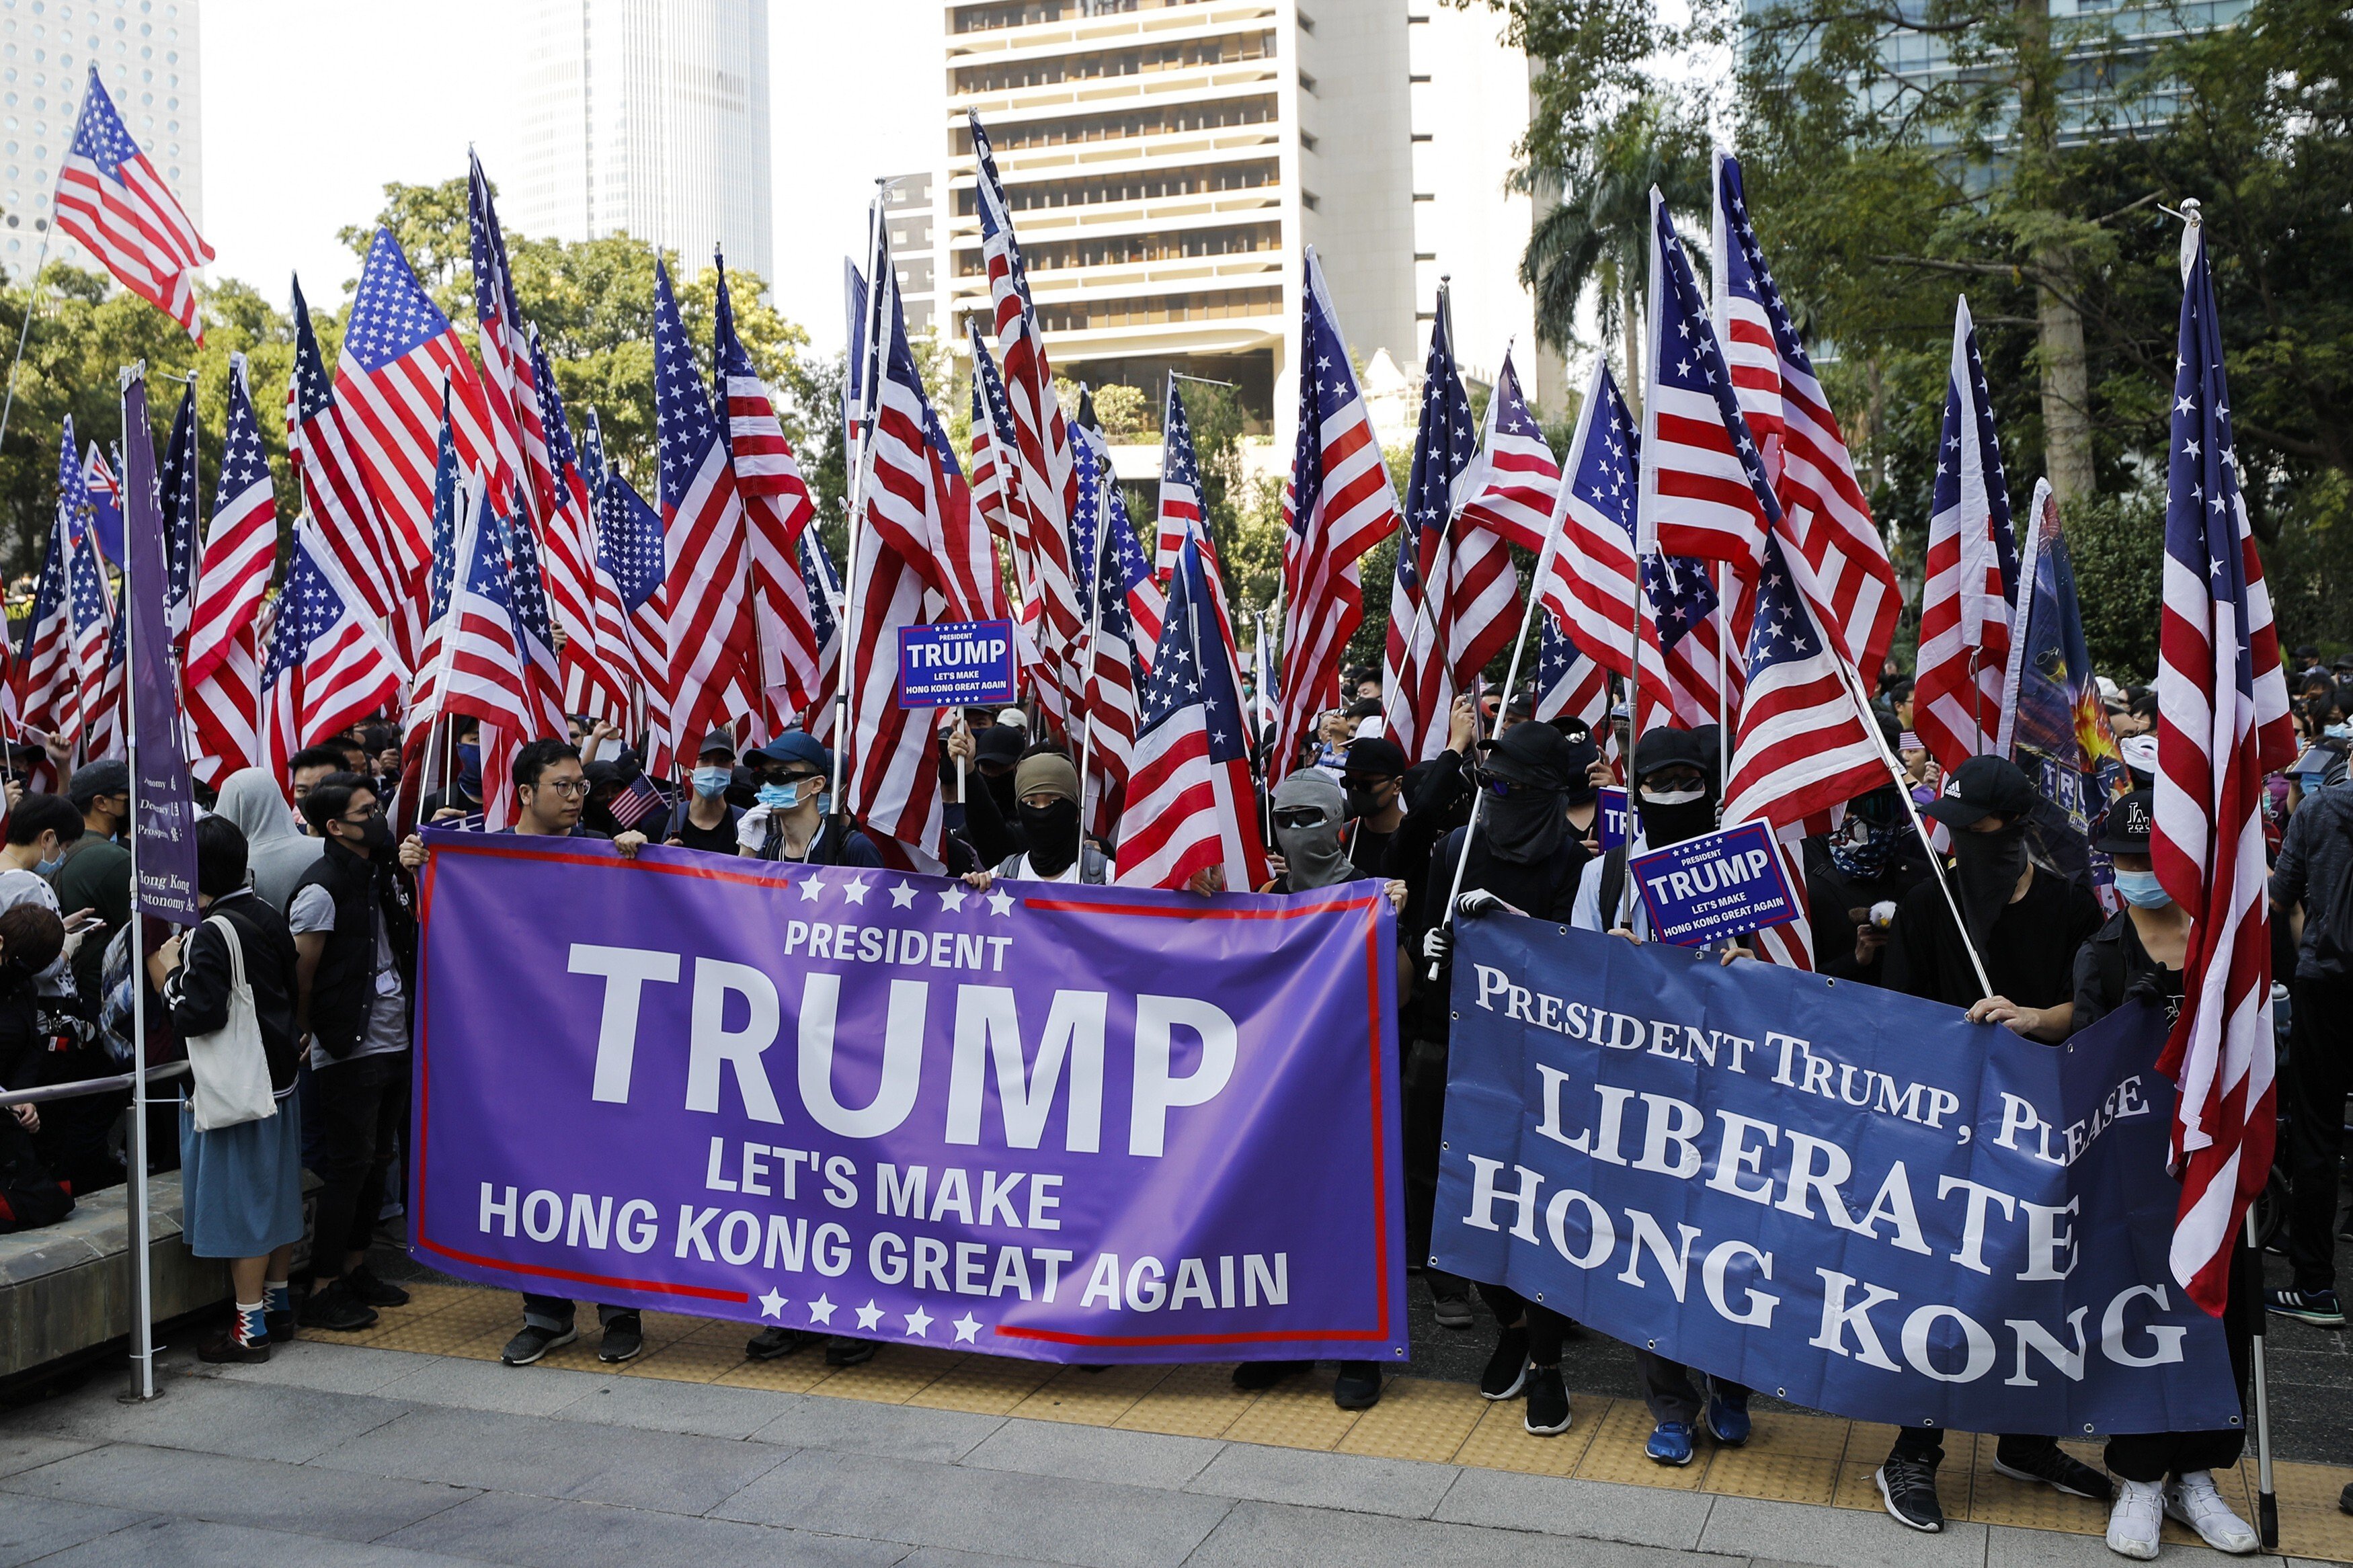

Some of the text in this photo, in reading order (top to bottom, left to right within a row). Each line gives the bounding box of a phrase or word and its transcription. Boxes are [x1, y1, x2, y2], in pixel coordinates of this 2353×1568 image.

[907, 639, 1006, 668] TRUMP
[906, 681, 1006, 694] HONG KONG GREAT AGAIN
[934, 671, 979, 681] LET'S MAKE
[1605, 809, 1644, 838] TRU
[2127, 802, 2150, 833] LA
[1681, 849, 1721, 866] PRESIDENT
[170, 874, 190, 894] Kong
[1646, 849, 1769, 905] TRUMP
[141, 893, 185, 913] utonomy
[1663, 923, 1692, 938] HONG
[1693, 915, 1720, 931] KONG
[1722, 905, 1752, 921] GREAT
[1753, 897, 1784, 913] AGAIN
[1691, 892, 1747, 915] LET'S MAKE
[784, 920, 1013, 972] PRESIDENT
[567, 943, 1238, 1158] TRUMP
[1473, 963, 2150, 1167] PRESIDENT TRUMP, PLEASE
[706, 1137, 1064, 1231] LET'S MAKE
[1536, 1063, 2080, 1281] LIBERATE
[479, 1182, 1289, 1313] HONG KONG GREAT AGAIN
[1462, 1154, 2188, 1387] HONG KONG
